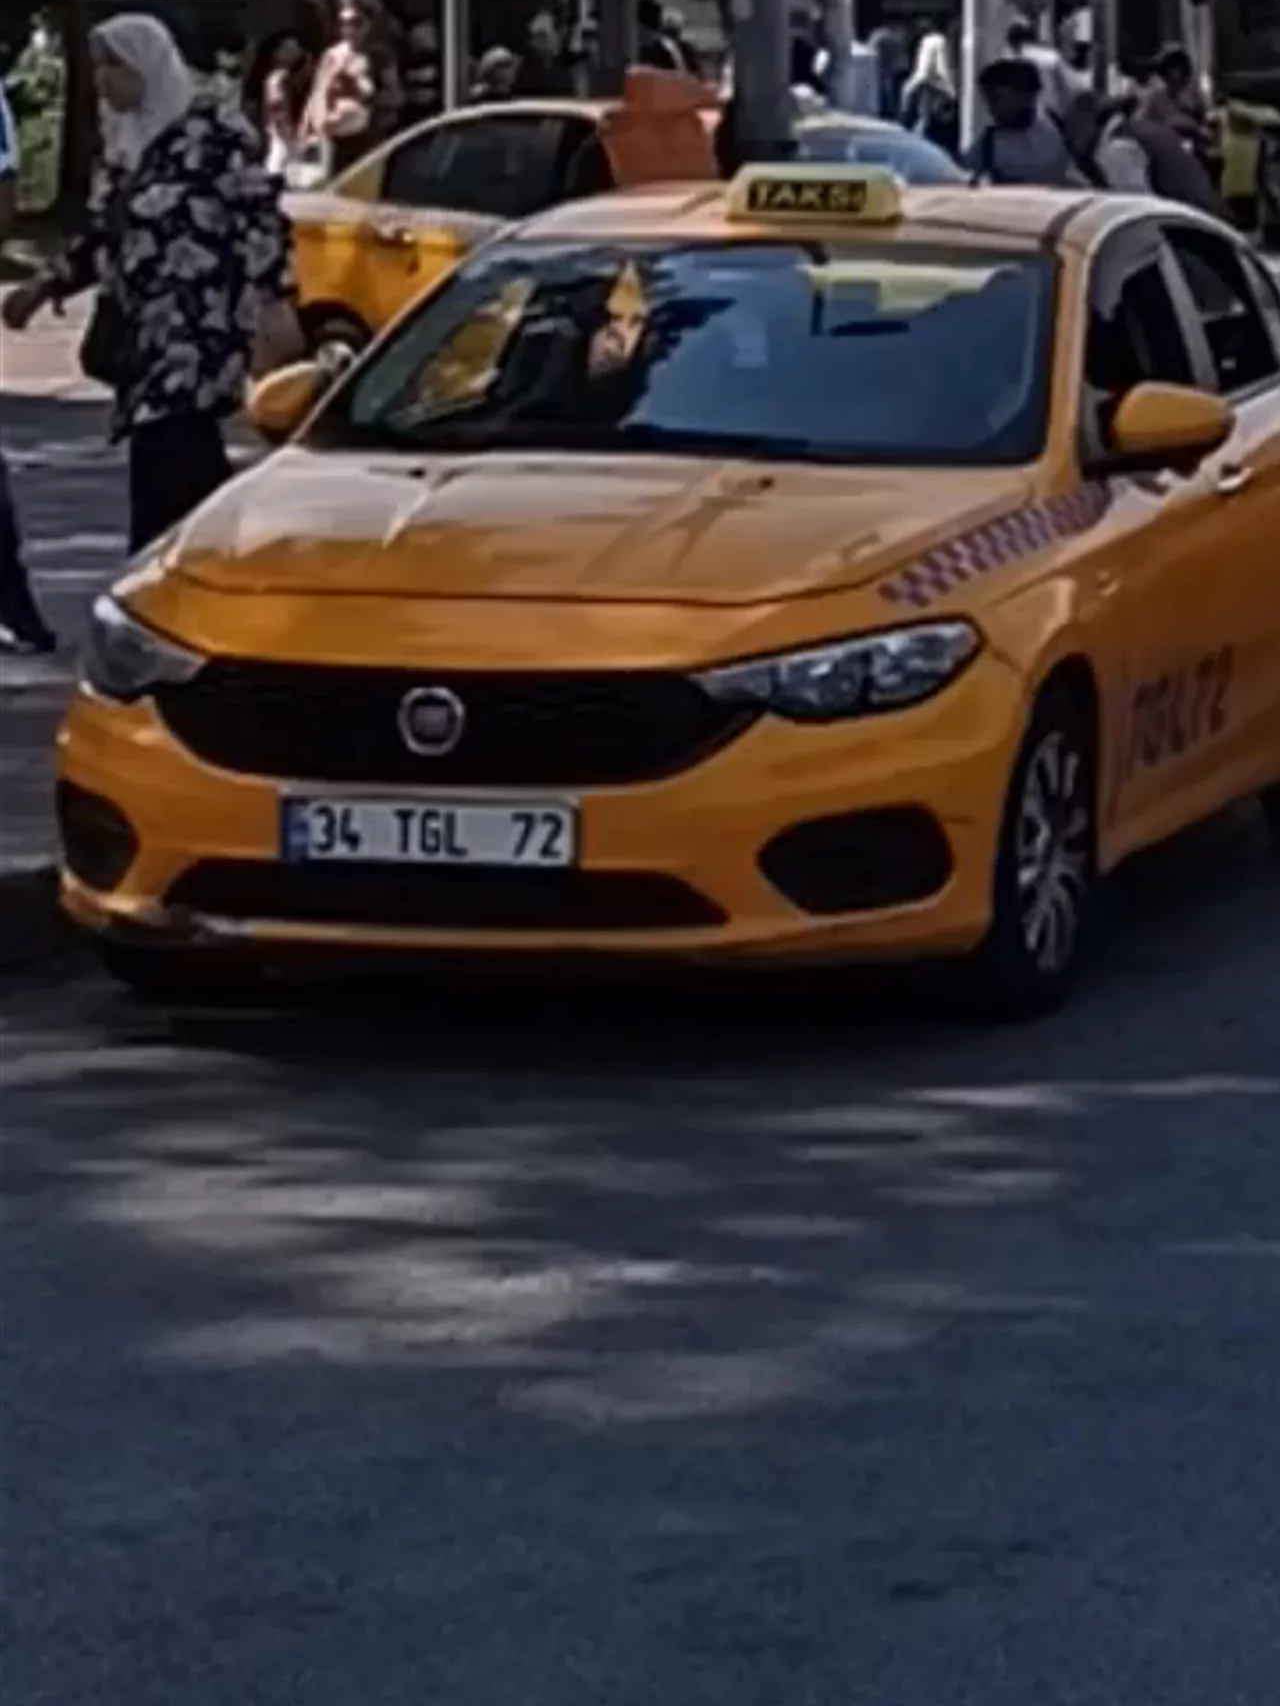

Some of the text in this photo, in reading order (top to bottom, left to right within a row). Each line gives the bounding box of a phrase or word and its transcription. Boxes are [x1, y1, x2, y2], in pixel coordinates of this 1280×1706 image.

[312, 805, 564, 859] 34 TGL 72
